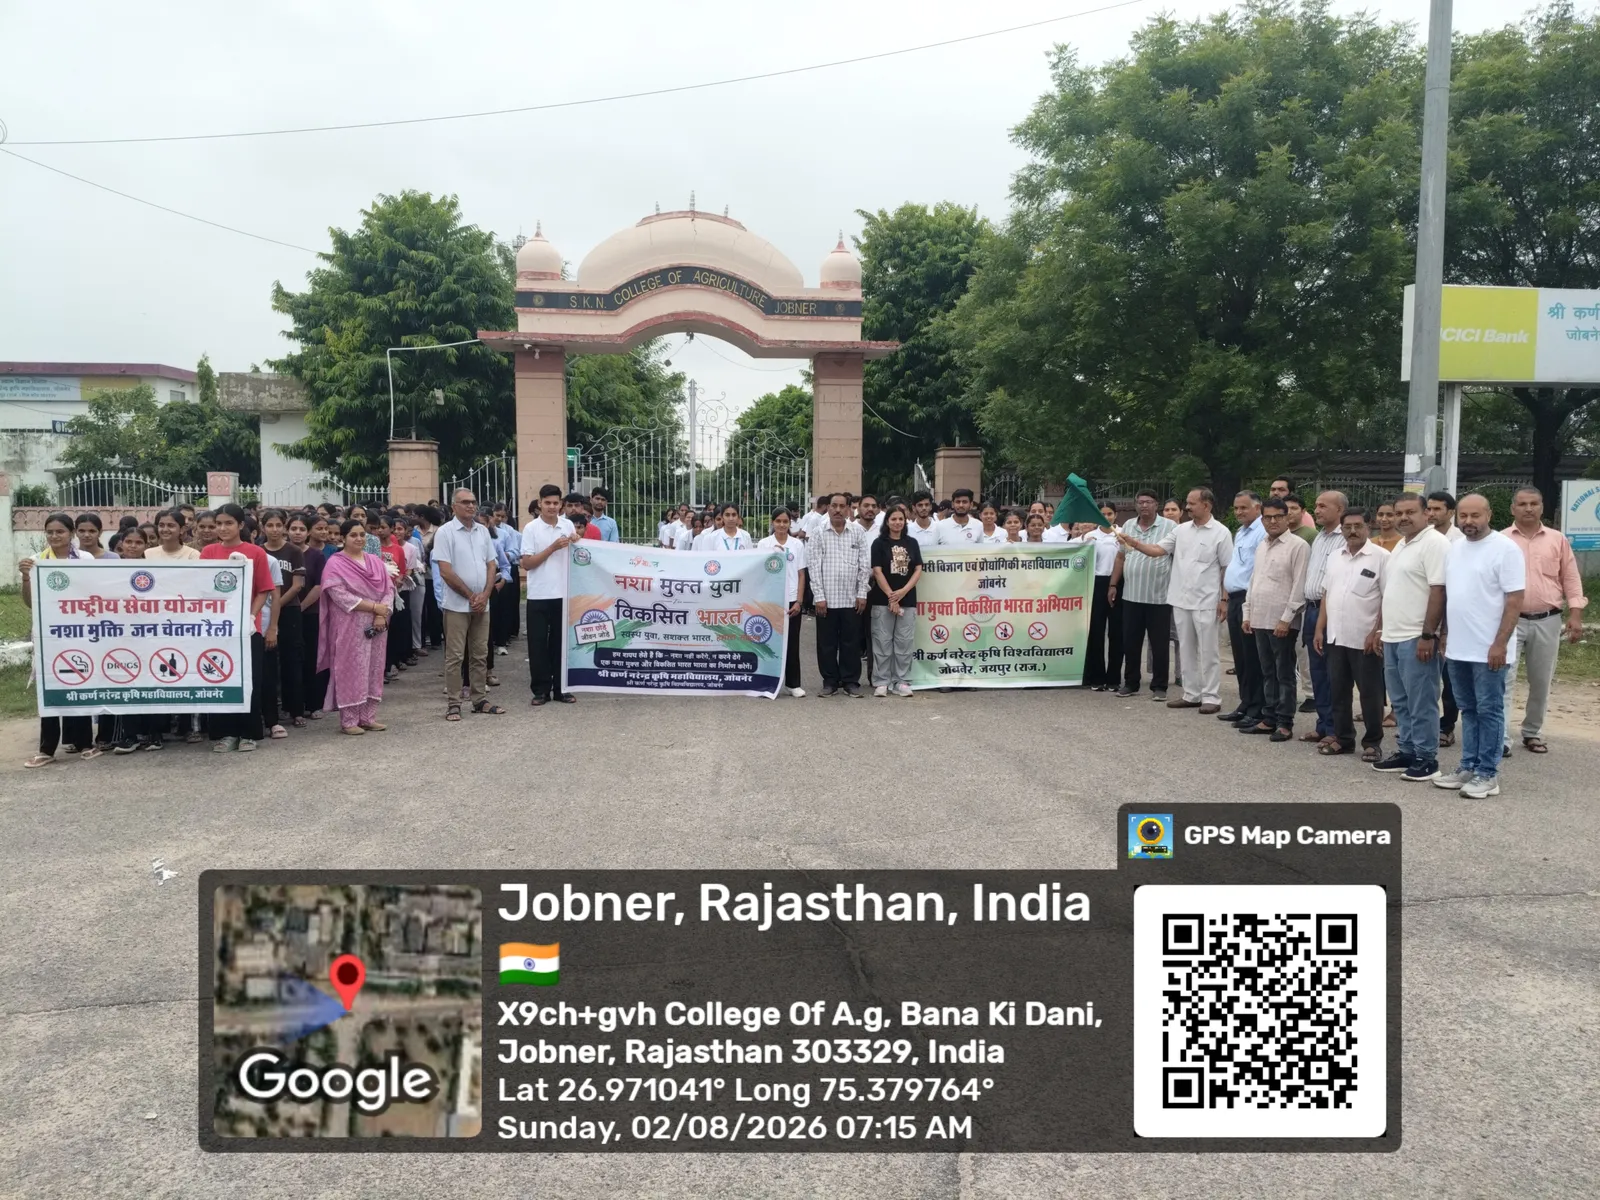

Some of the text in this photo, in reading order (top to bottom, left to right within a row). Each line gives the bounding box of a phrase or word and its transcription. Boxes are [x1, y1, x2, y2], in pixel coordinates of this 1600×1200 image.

[614, 275, 664, 305] COLLEGE
[667, 271, 682, 284] OF
[693, 270, 767, 308] AGRICULTURE
[775, 302, 817, 315] JOBNER
[1547, 302, 1600, 320] श्री कर्ण
[1483, 329, 1529, 343] Bank
[1565, 325, 1600, 341] जोबने
[1570, 488, 1595, 512] NATIONAL
[936, 559, 963, 572] विज्ञान
[965, 558, 979, 572] एवं
[979, 557, 1019, 571] प्रौद्योगिकी
[1021, 556, 1070, 570] महाविद्यालय
[615, 575, 741, 598] नशा मुक्त युवा
[978, 575, 1007, 589] जोबनेर
[58, 594, 227, 617] राष्ट्रीय सेवा योजना
[615, 599, 744, 625] विकसित भारत
[927, 602, 954, 621] मुक्त
[955, 595, 1002, 616] विकसित
[1004, 598, 1034, 613] भारत
[1036, 594, 1083, 613] अभियान
[49, 619, 234, 643] नशा मुक्ति जन चेतना रैली
[644, 632, 660, 640] युवा,
[663, 633, 689, 642] सशक्त
[692, 634, 713, 642] भारत,
[912, 645, 1074, 662] श्री कर्ण नरेन्द्र कृषि विश्वविद्यालय
[598, 669, 753, 682] श्री कर्ण नरेन्द्र कृषि महाविद्यालय, जोबनेर
[939, 662, 977, 675] जोबनेर,
[979, 663, 1011, 676] जयपुर
[66, 688, 224, 702] श्री कर्ण नरेन्द्र कृषि महाविद्यालय, जोबनेर
